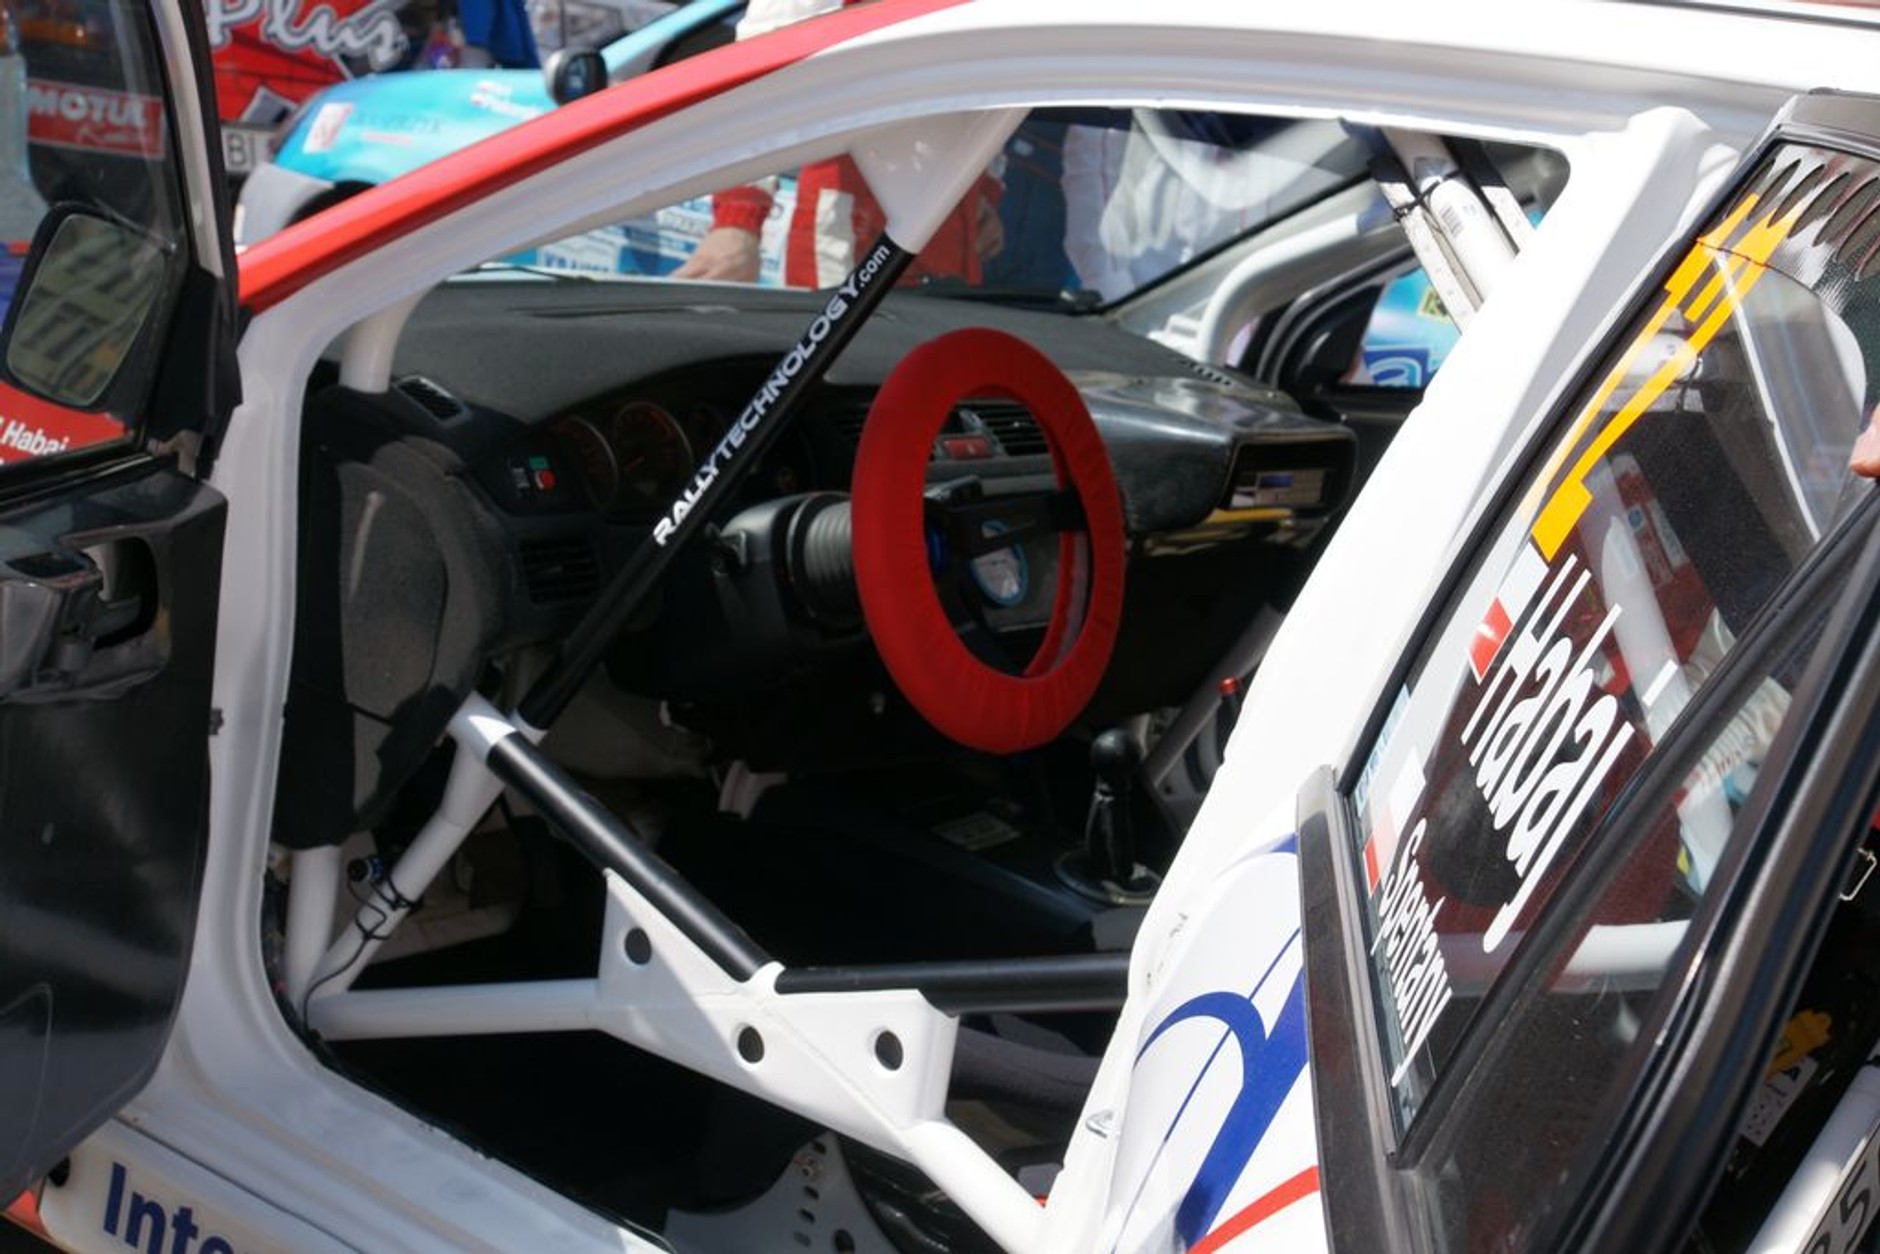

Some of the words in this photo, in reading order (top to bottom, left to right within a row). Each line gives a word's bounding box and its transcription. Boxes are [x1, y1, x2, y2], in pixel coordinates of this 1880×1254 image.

[28, 85, 147, 127] MOTUL
[206, 0, 406, 68] Plus
[652, 245, 891, 546] RALLYTECHNOLOGY.com
[1460, 552, 1678, 953] Habaj
[1370, 817, 1453, 1088] Spentany
